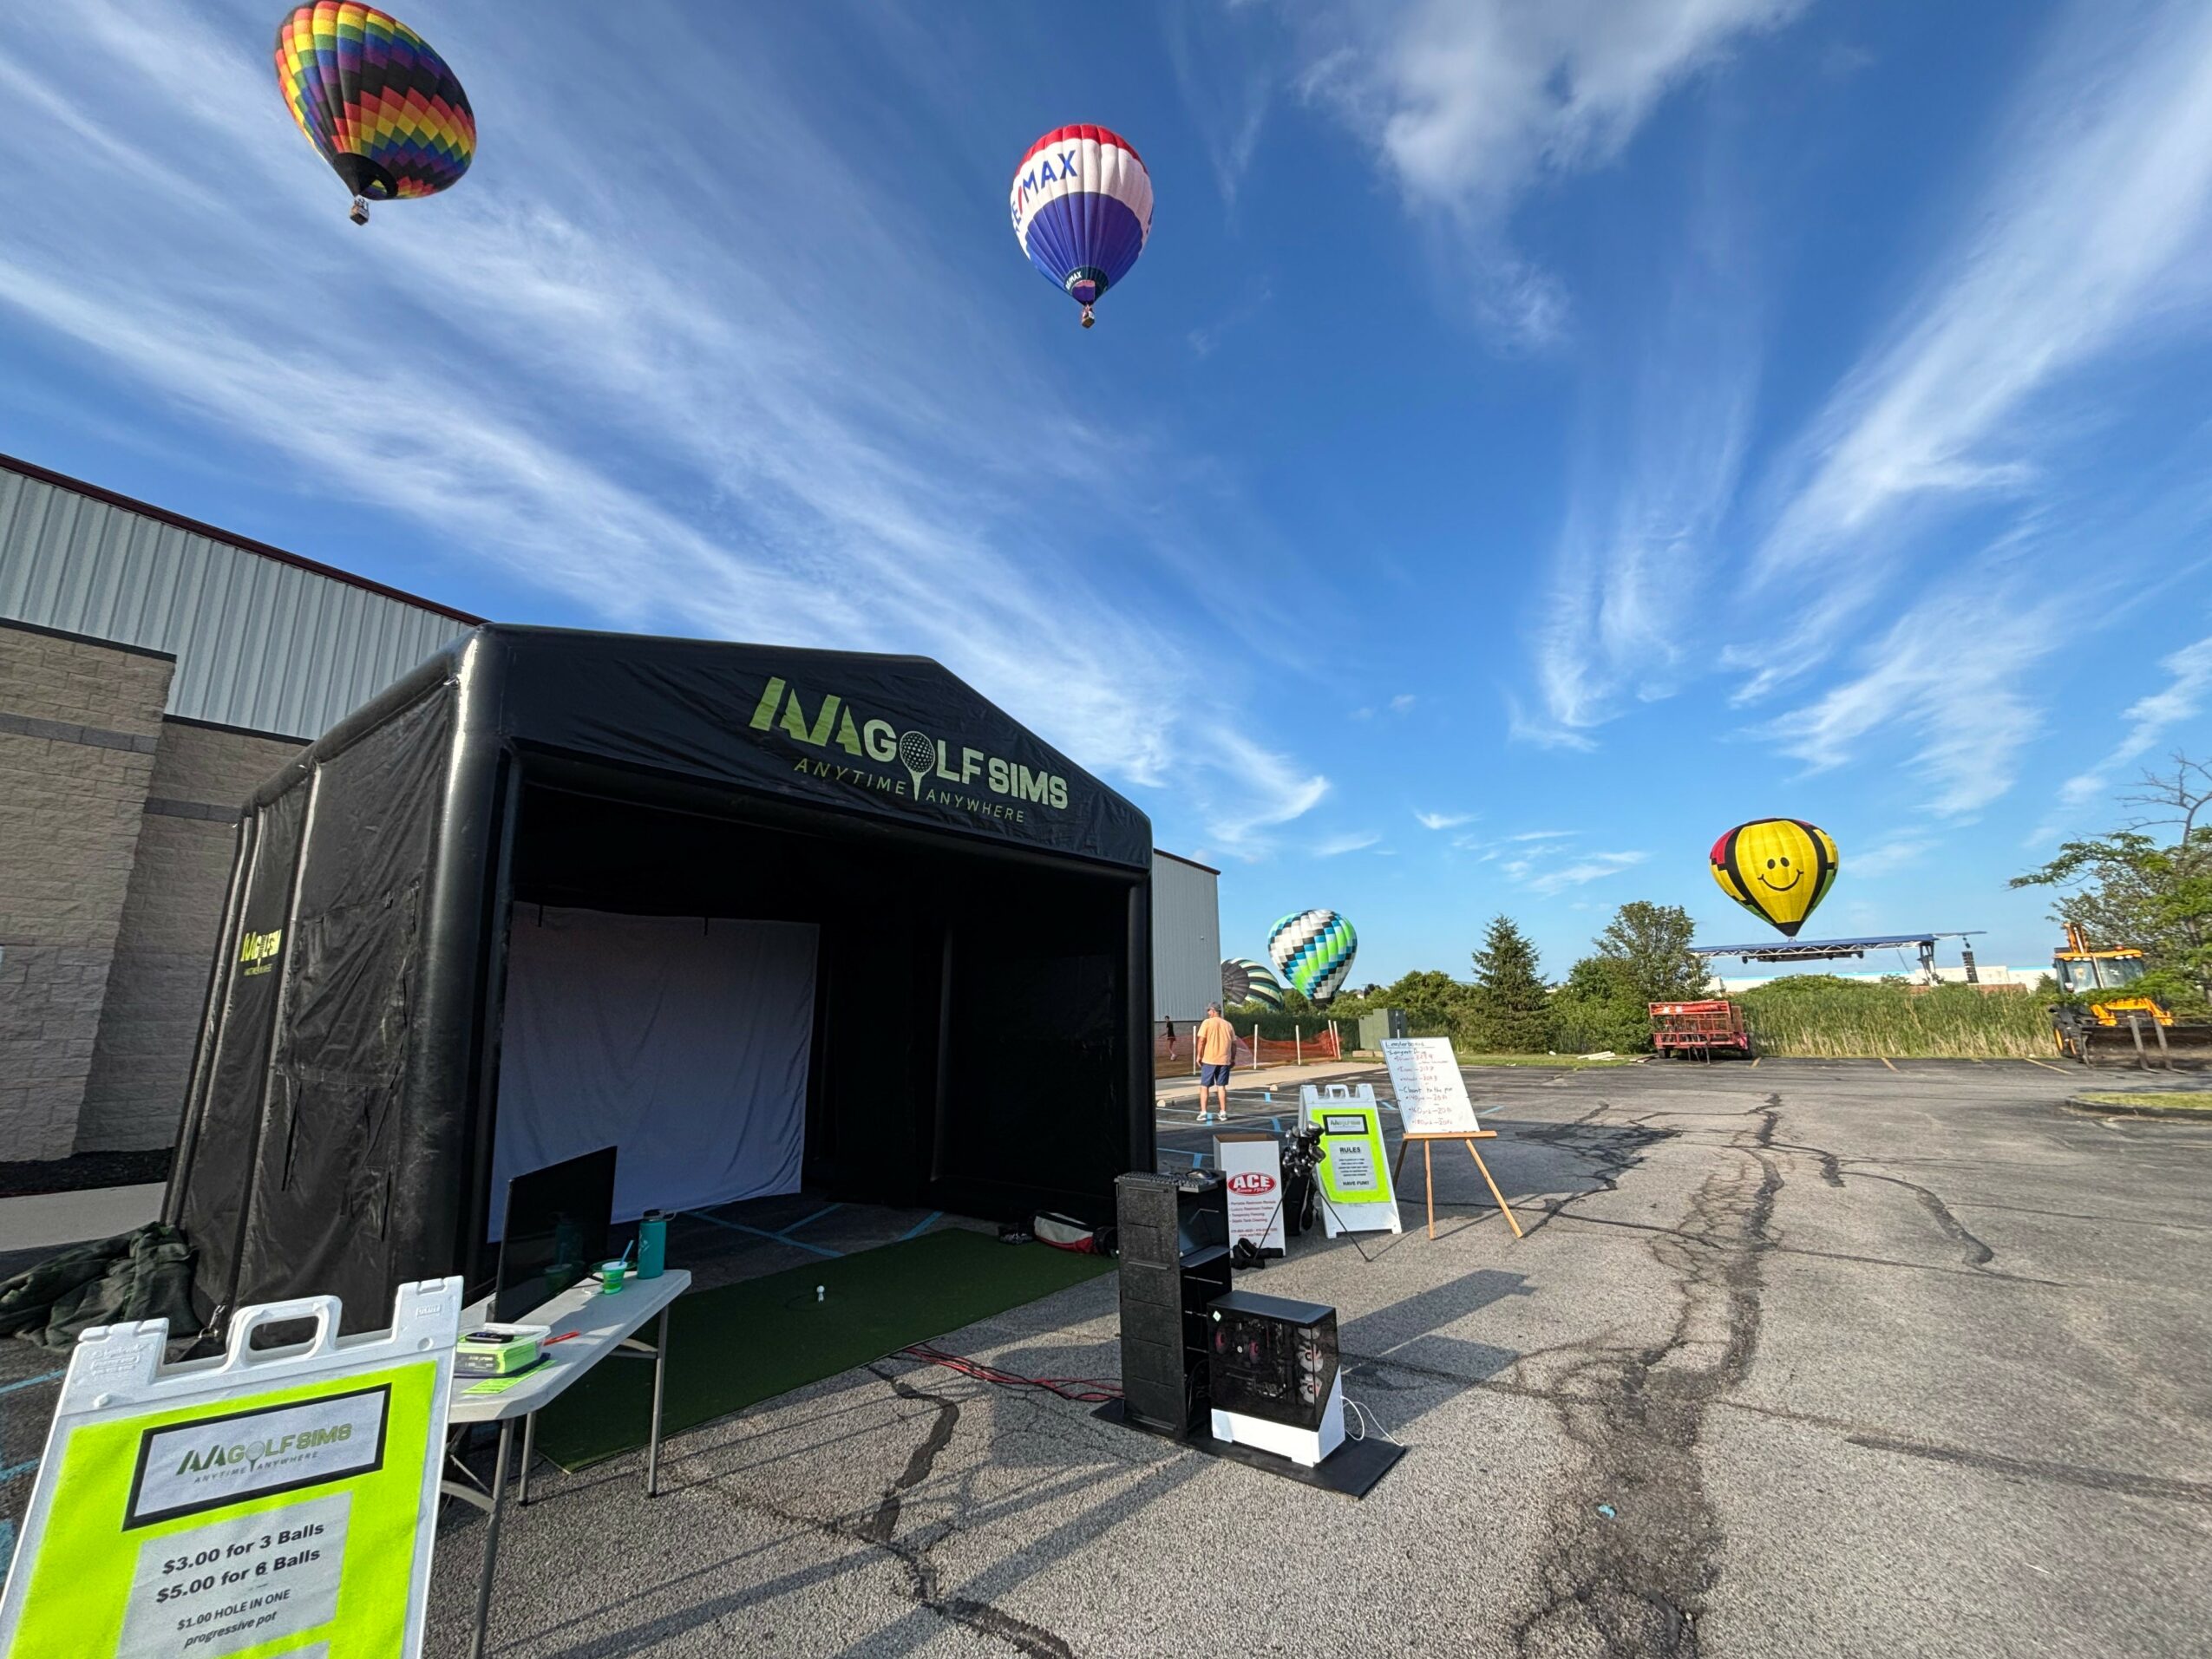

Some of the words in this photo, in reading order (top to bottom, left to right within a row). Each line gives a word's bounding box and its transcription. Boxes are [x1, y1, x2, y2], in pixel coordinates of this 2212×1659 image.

[794, 757, 906, 795] ANYTIME
[925, 788, 1025, 823] ANYWHERE
[1233, 1174, 1271, 1189] ACE
[193, 1467, 246, 1484] ANYTIME
[257, 1451, 318, 1471] ANYWHERE
[162, 1549, 220, 1575] $3.00
[226, 1541, 255, 1558] for
[259, 1535, 272, 1549] 3
[278, 1524, 324, 1545] Balls
[156, 1576, 215, 1603] $5.00
[220, 1568, 251, 1585] for
[255, 1562, 267, 1576] 6
[273, 1549, 320, 1571] Balls
[177, 1612, 212, 1631] $1.00
[213, 1601, 247, 1620] HOLE
[249, 1597, 262, 1610] IN
[265, 1589, 291, 1604] ONE
[183, 1617, 254, 1649] progressive
